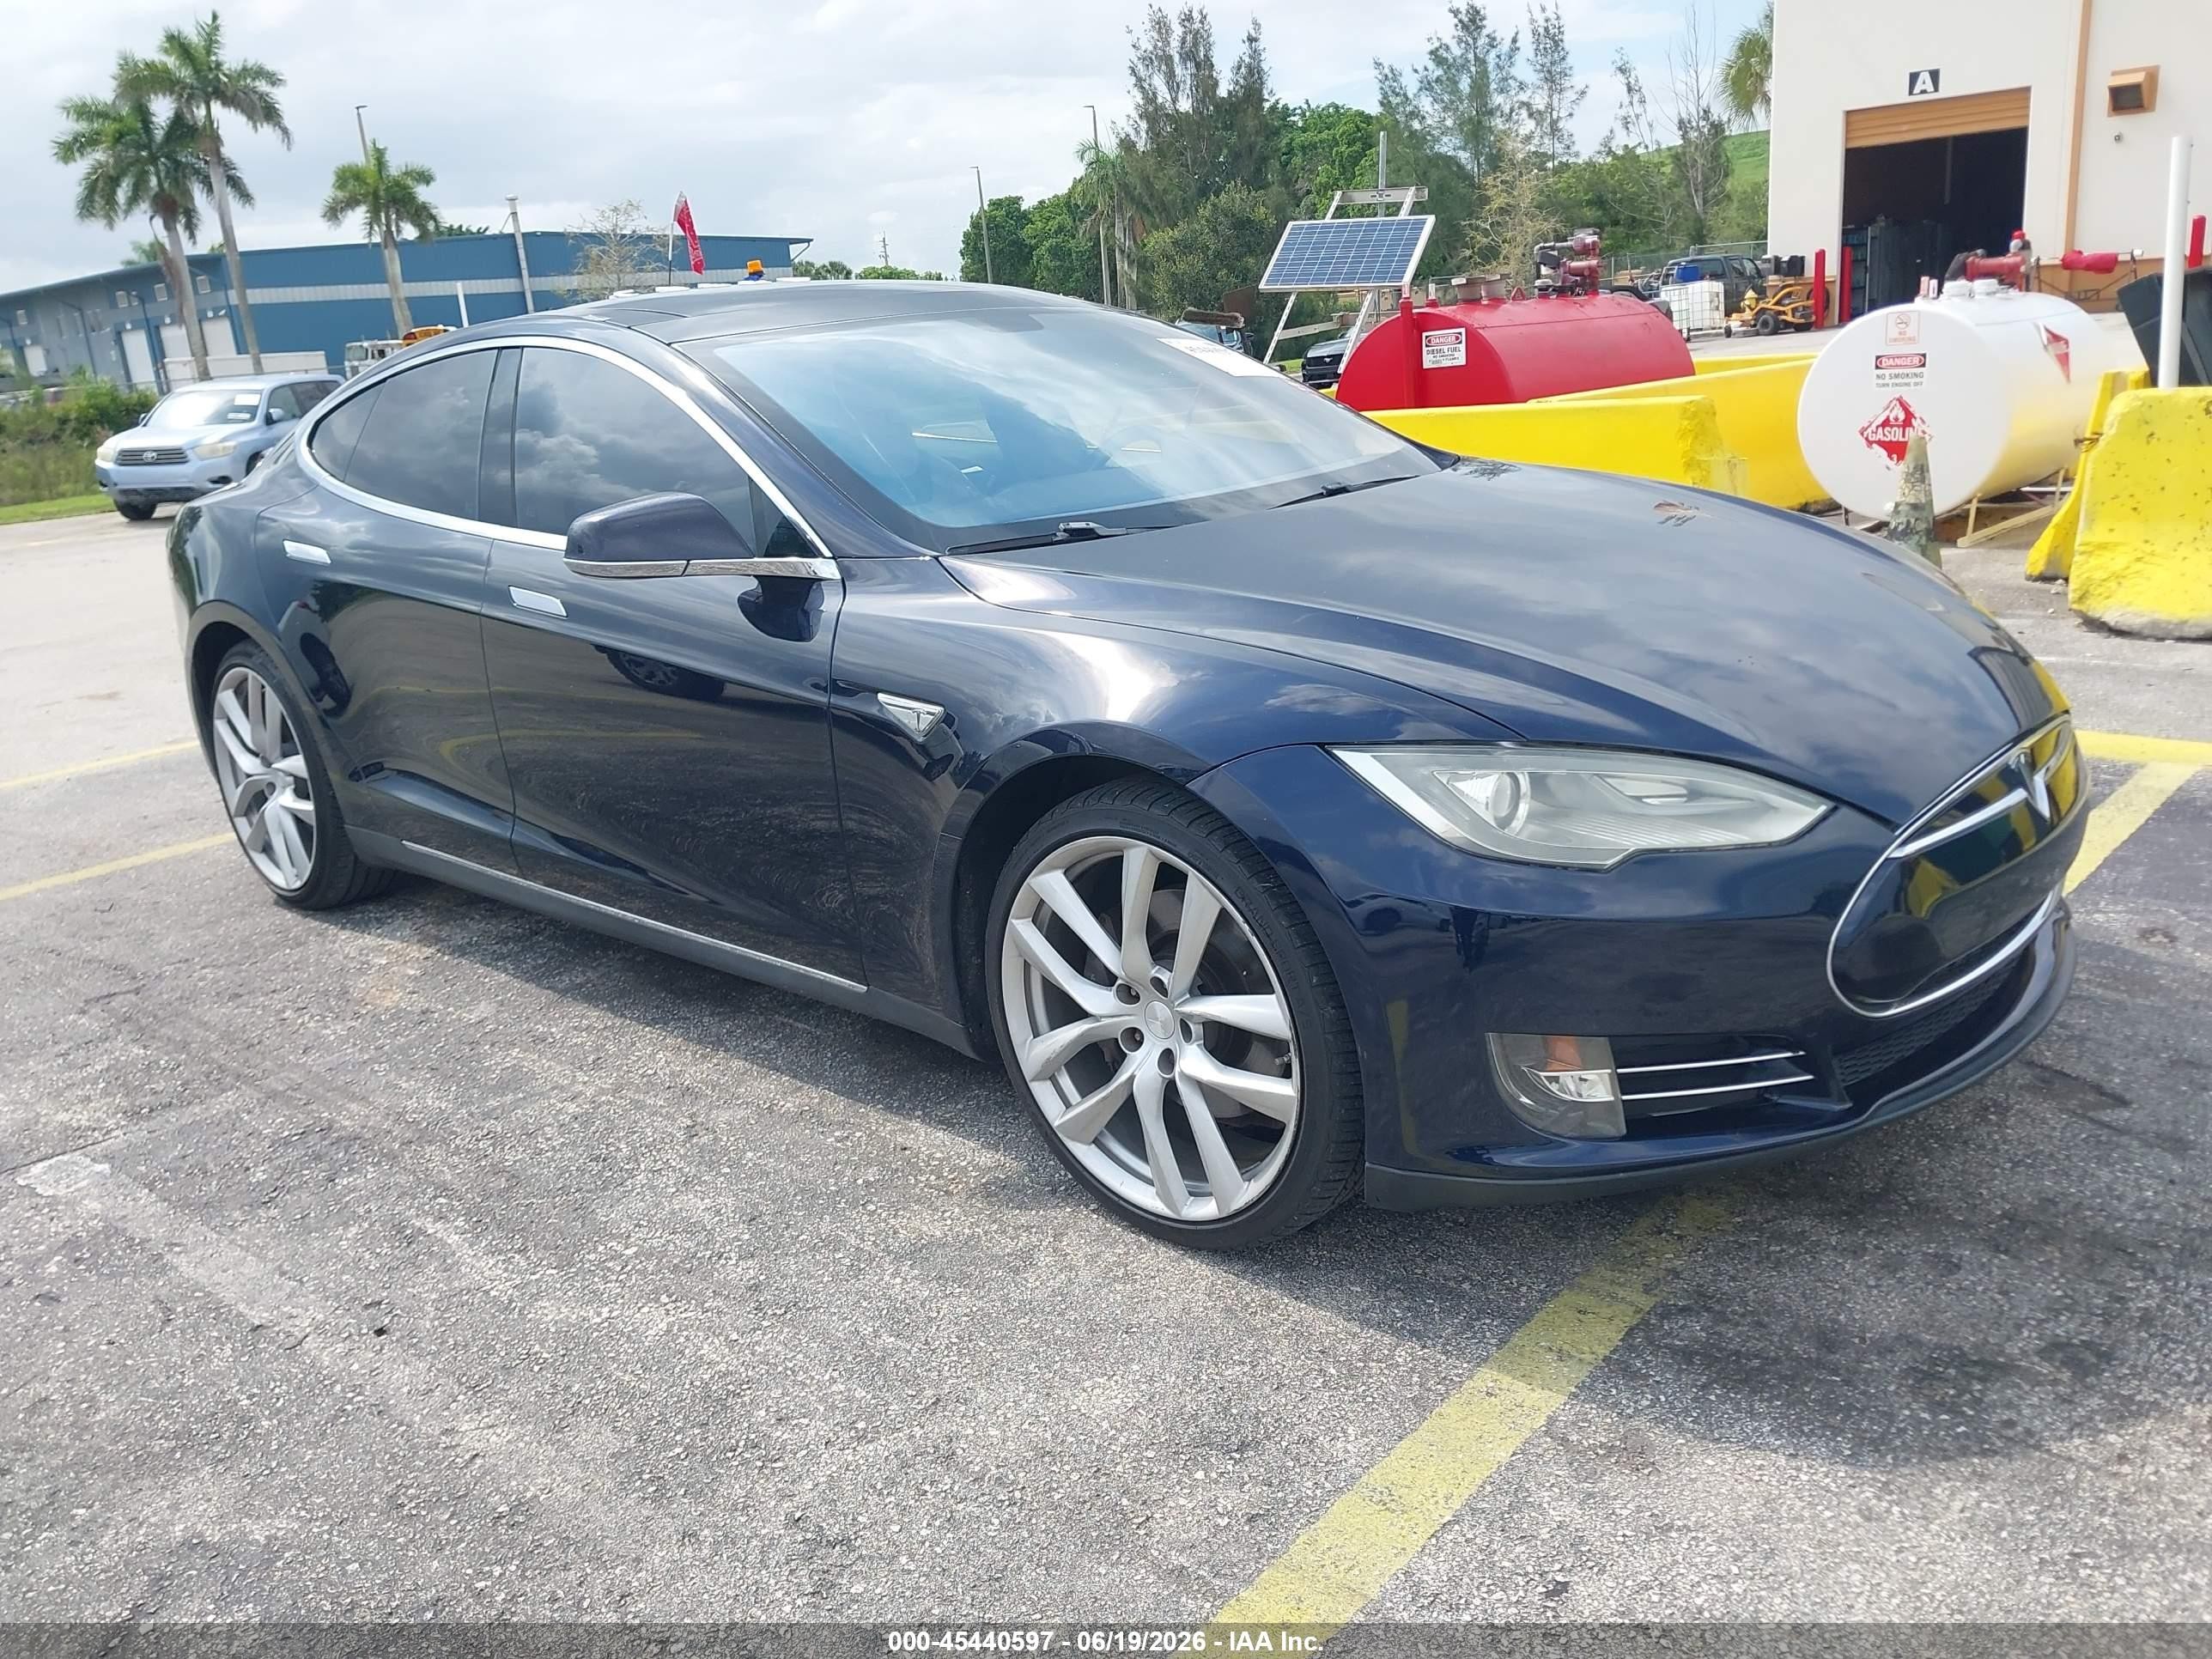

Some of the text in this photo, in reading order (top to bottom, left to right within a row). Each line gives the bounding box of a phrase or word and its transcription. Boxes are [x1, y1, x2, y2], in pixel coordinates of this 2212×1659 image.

[1913, 70, 1935, 94] A
[1431, 336, 1456, 344] DANGER
[1881, 356, 1919, 366] DANGER
